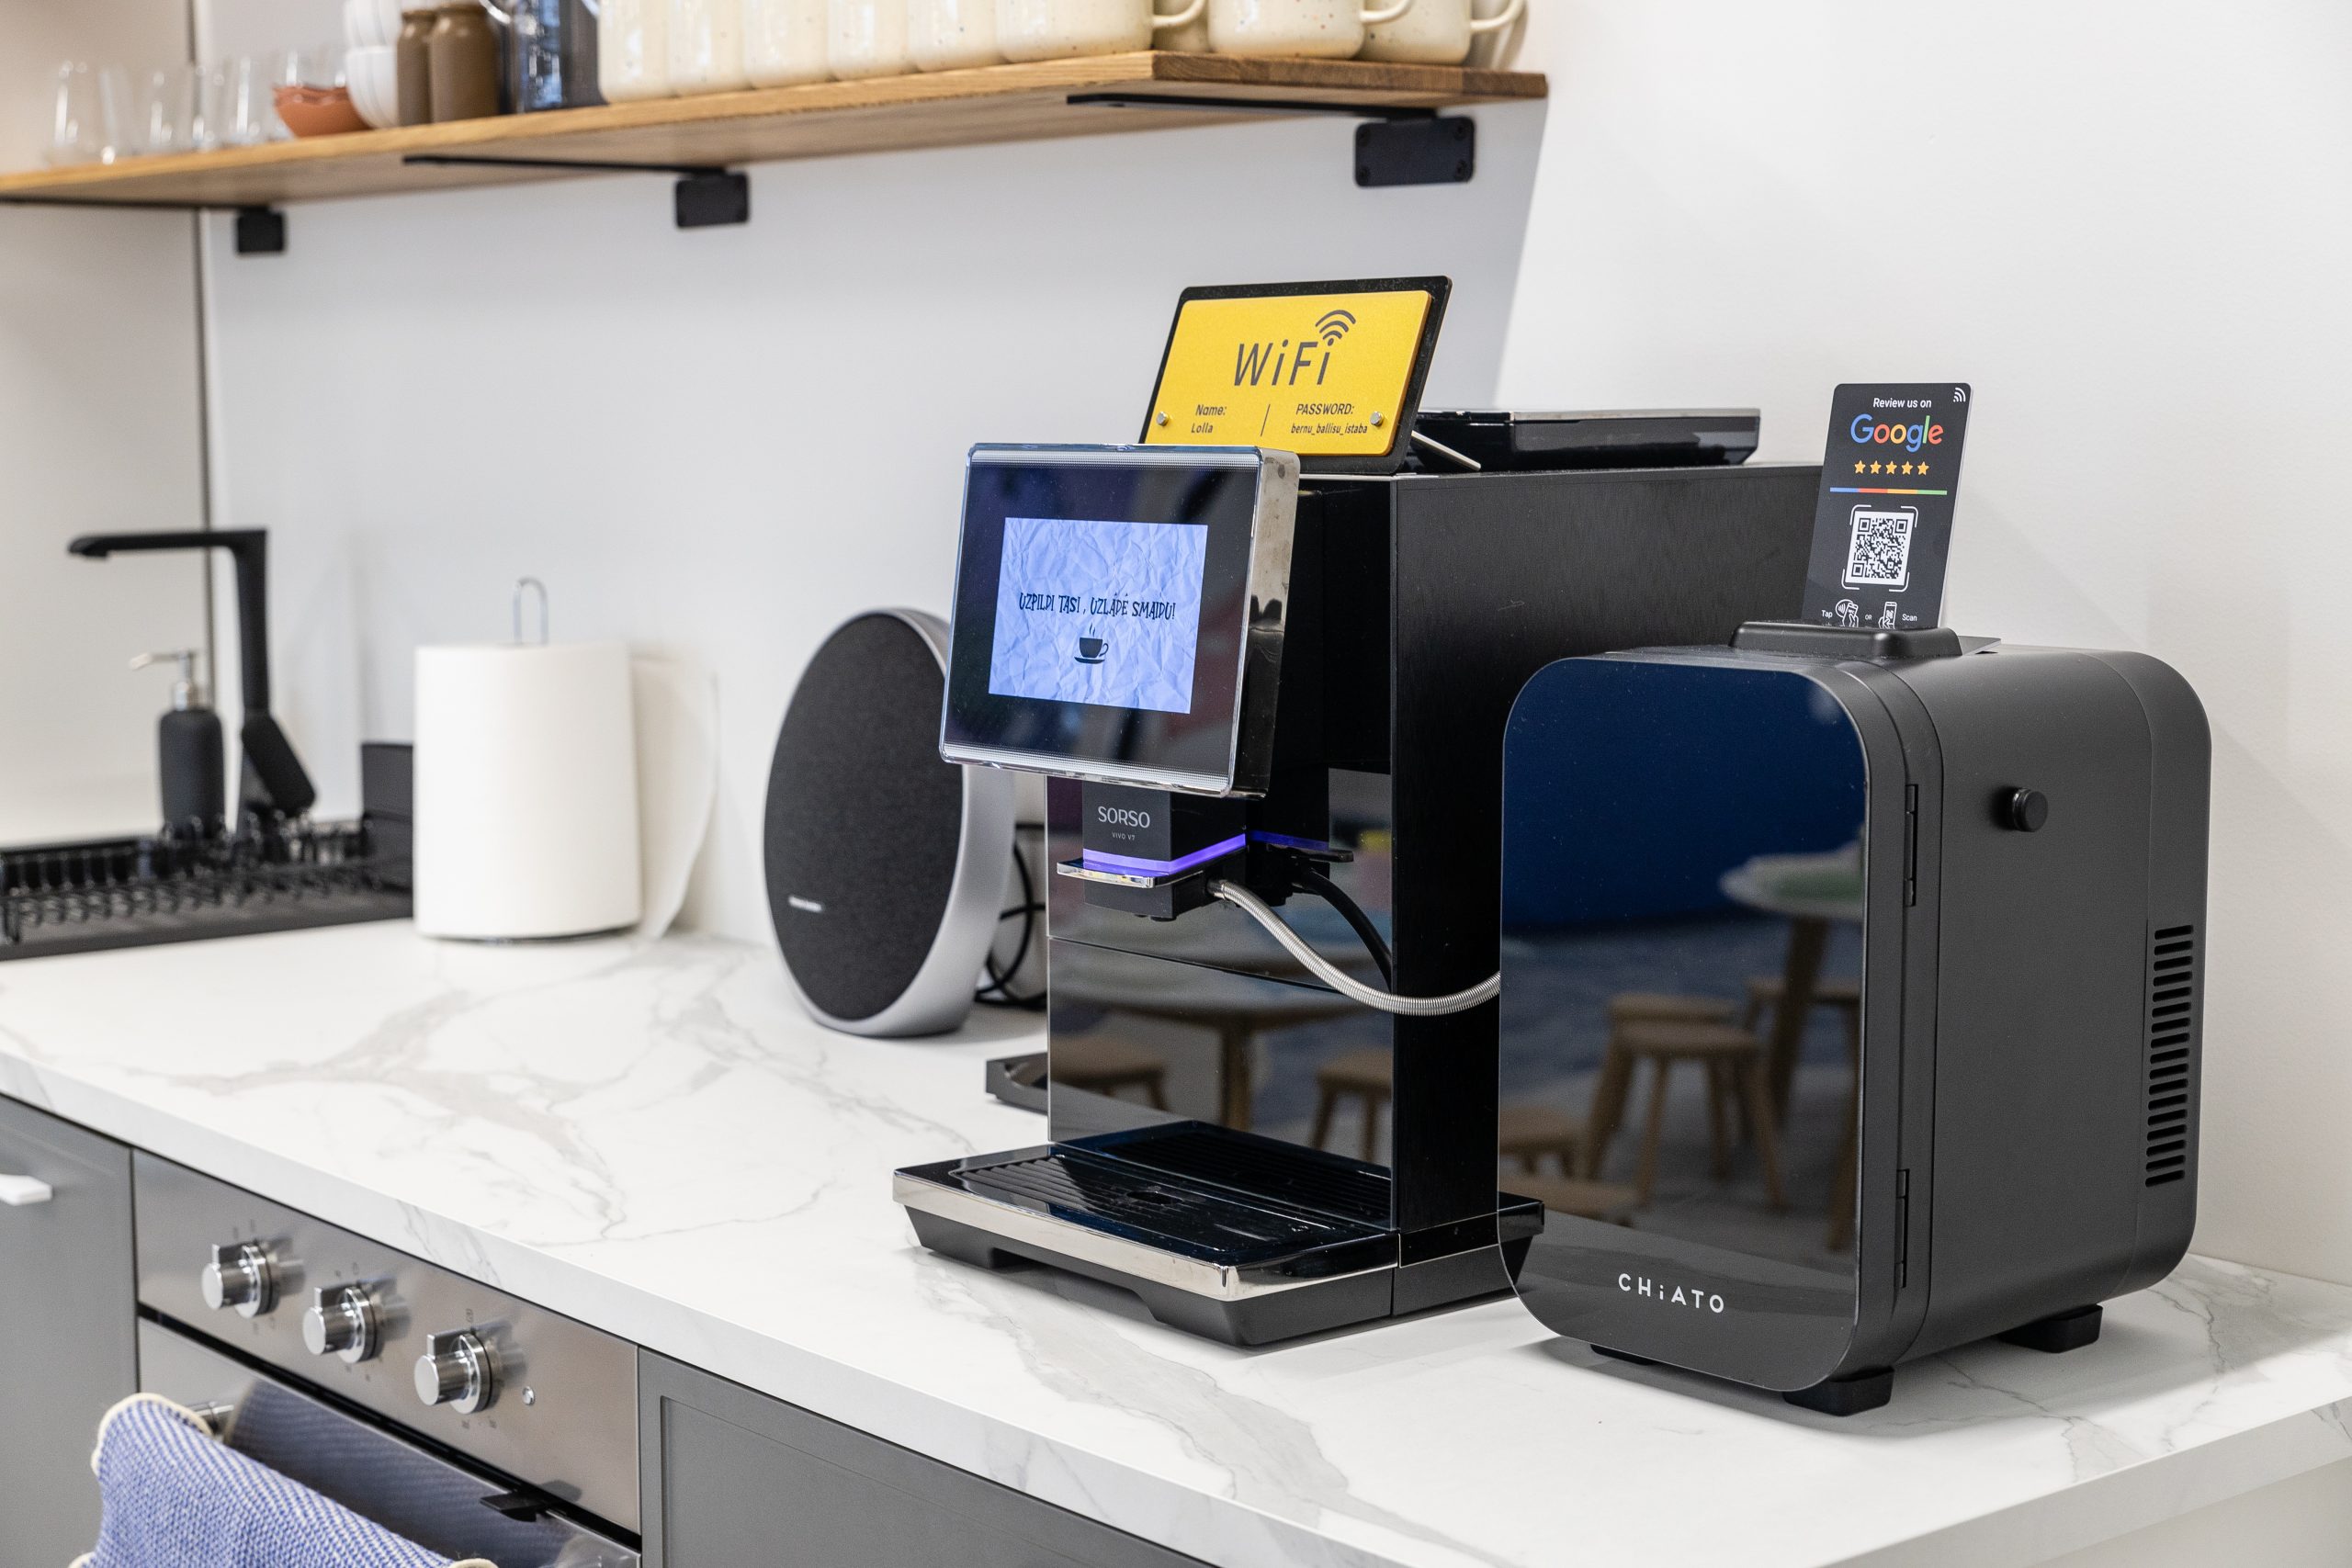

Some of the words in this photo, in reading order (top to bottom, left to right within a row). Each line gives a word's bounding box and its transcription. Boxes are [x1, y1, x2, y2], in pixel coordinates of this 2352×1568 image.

[1234, 338, 1334, 386] WiFi
[1195, 403, 1227, 416] Name:
[1295, 403, 1354, 415] PASSWORD:
[1872, 397, 1905, 409] Review
[1906, 399, 1918, 409] us
[1919, 399, 1932, 409] on
[1191, 422, 1213, 434] Lolla
[1291, 423, 1368, 436] bernu_ballisu_istaba
[1850, 413, 1944, 453] Google
[1019, 592, 1056, 612] UZPILDI
[1131, 600, 1177, 620] SMAIDU!
[1821, 609, 1833, 619] Tap
[1902, 613, 1917, 622] Scan
[1097, 806, 1150, 829] SORSO
[1112, 831, 1125, 840] VIVO
